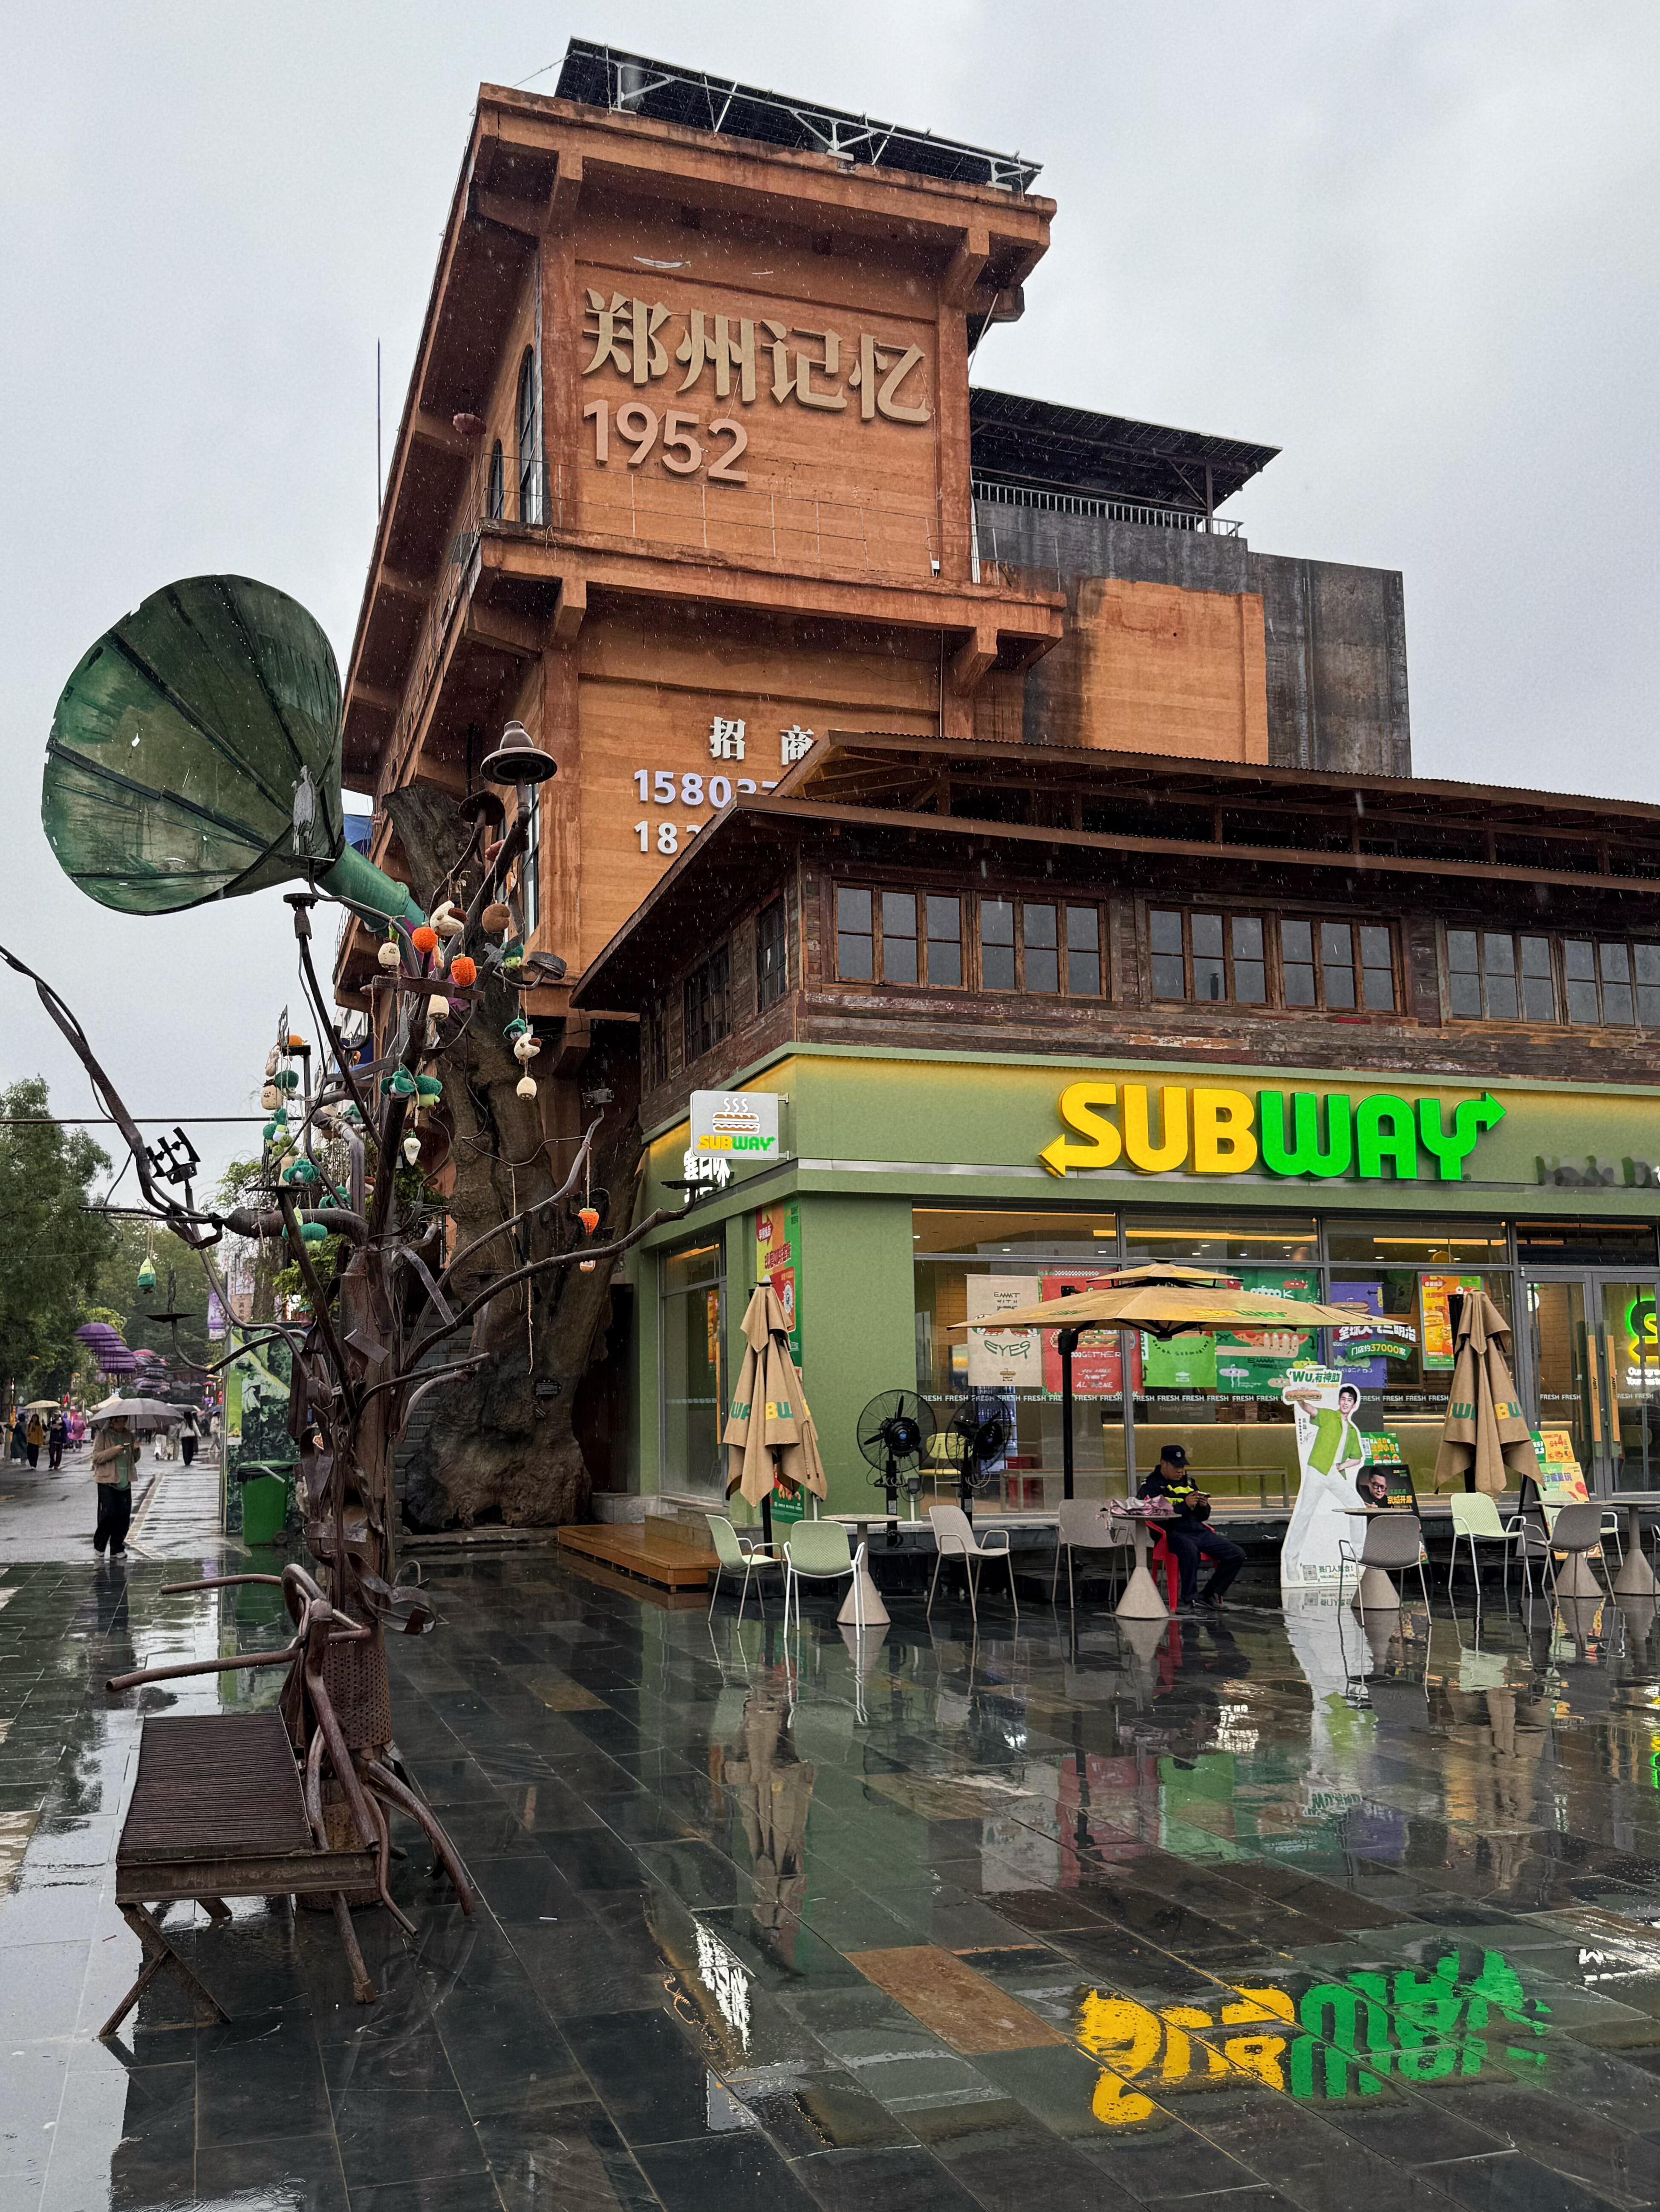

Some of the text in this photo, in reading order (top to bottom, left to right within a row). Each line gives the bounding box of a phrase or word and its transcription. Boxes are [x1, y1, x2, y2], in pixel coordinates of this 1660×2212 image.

[581, 288, 932, 423] 郑州记忆
[583, 399, 748, 484] 1952
[696, 1135, 776, 1151] SUBWAY
[1038, 1082, 1507, 1180] SUBWAY
[984, 1340, 1031, 1359] EYES
[1351, 1343, 1406, 1356] 门店约37000家
